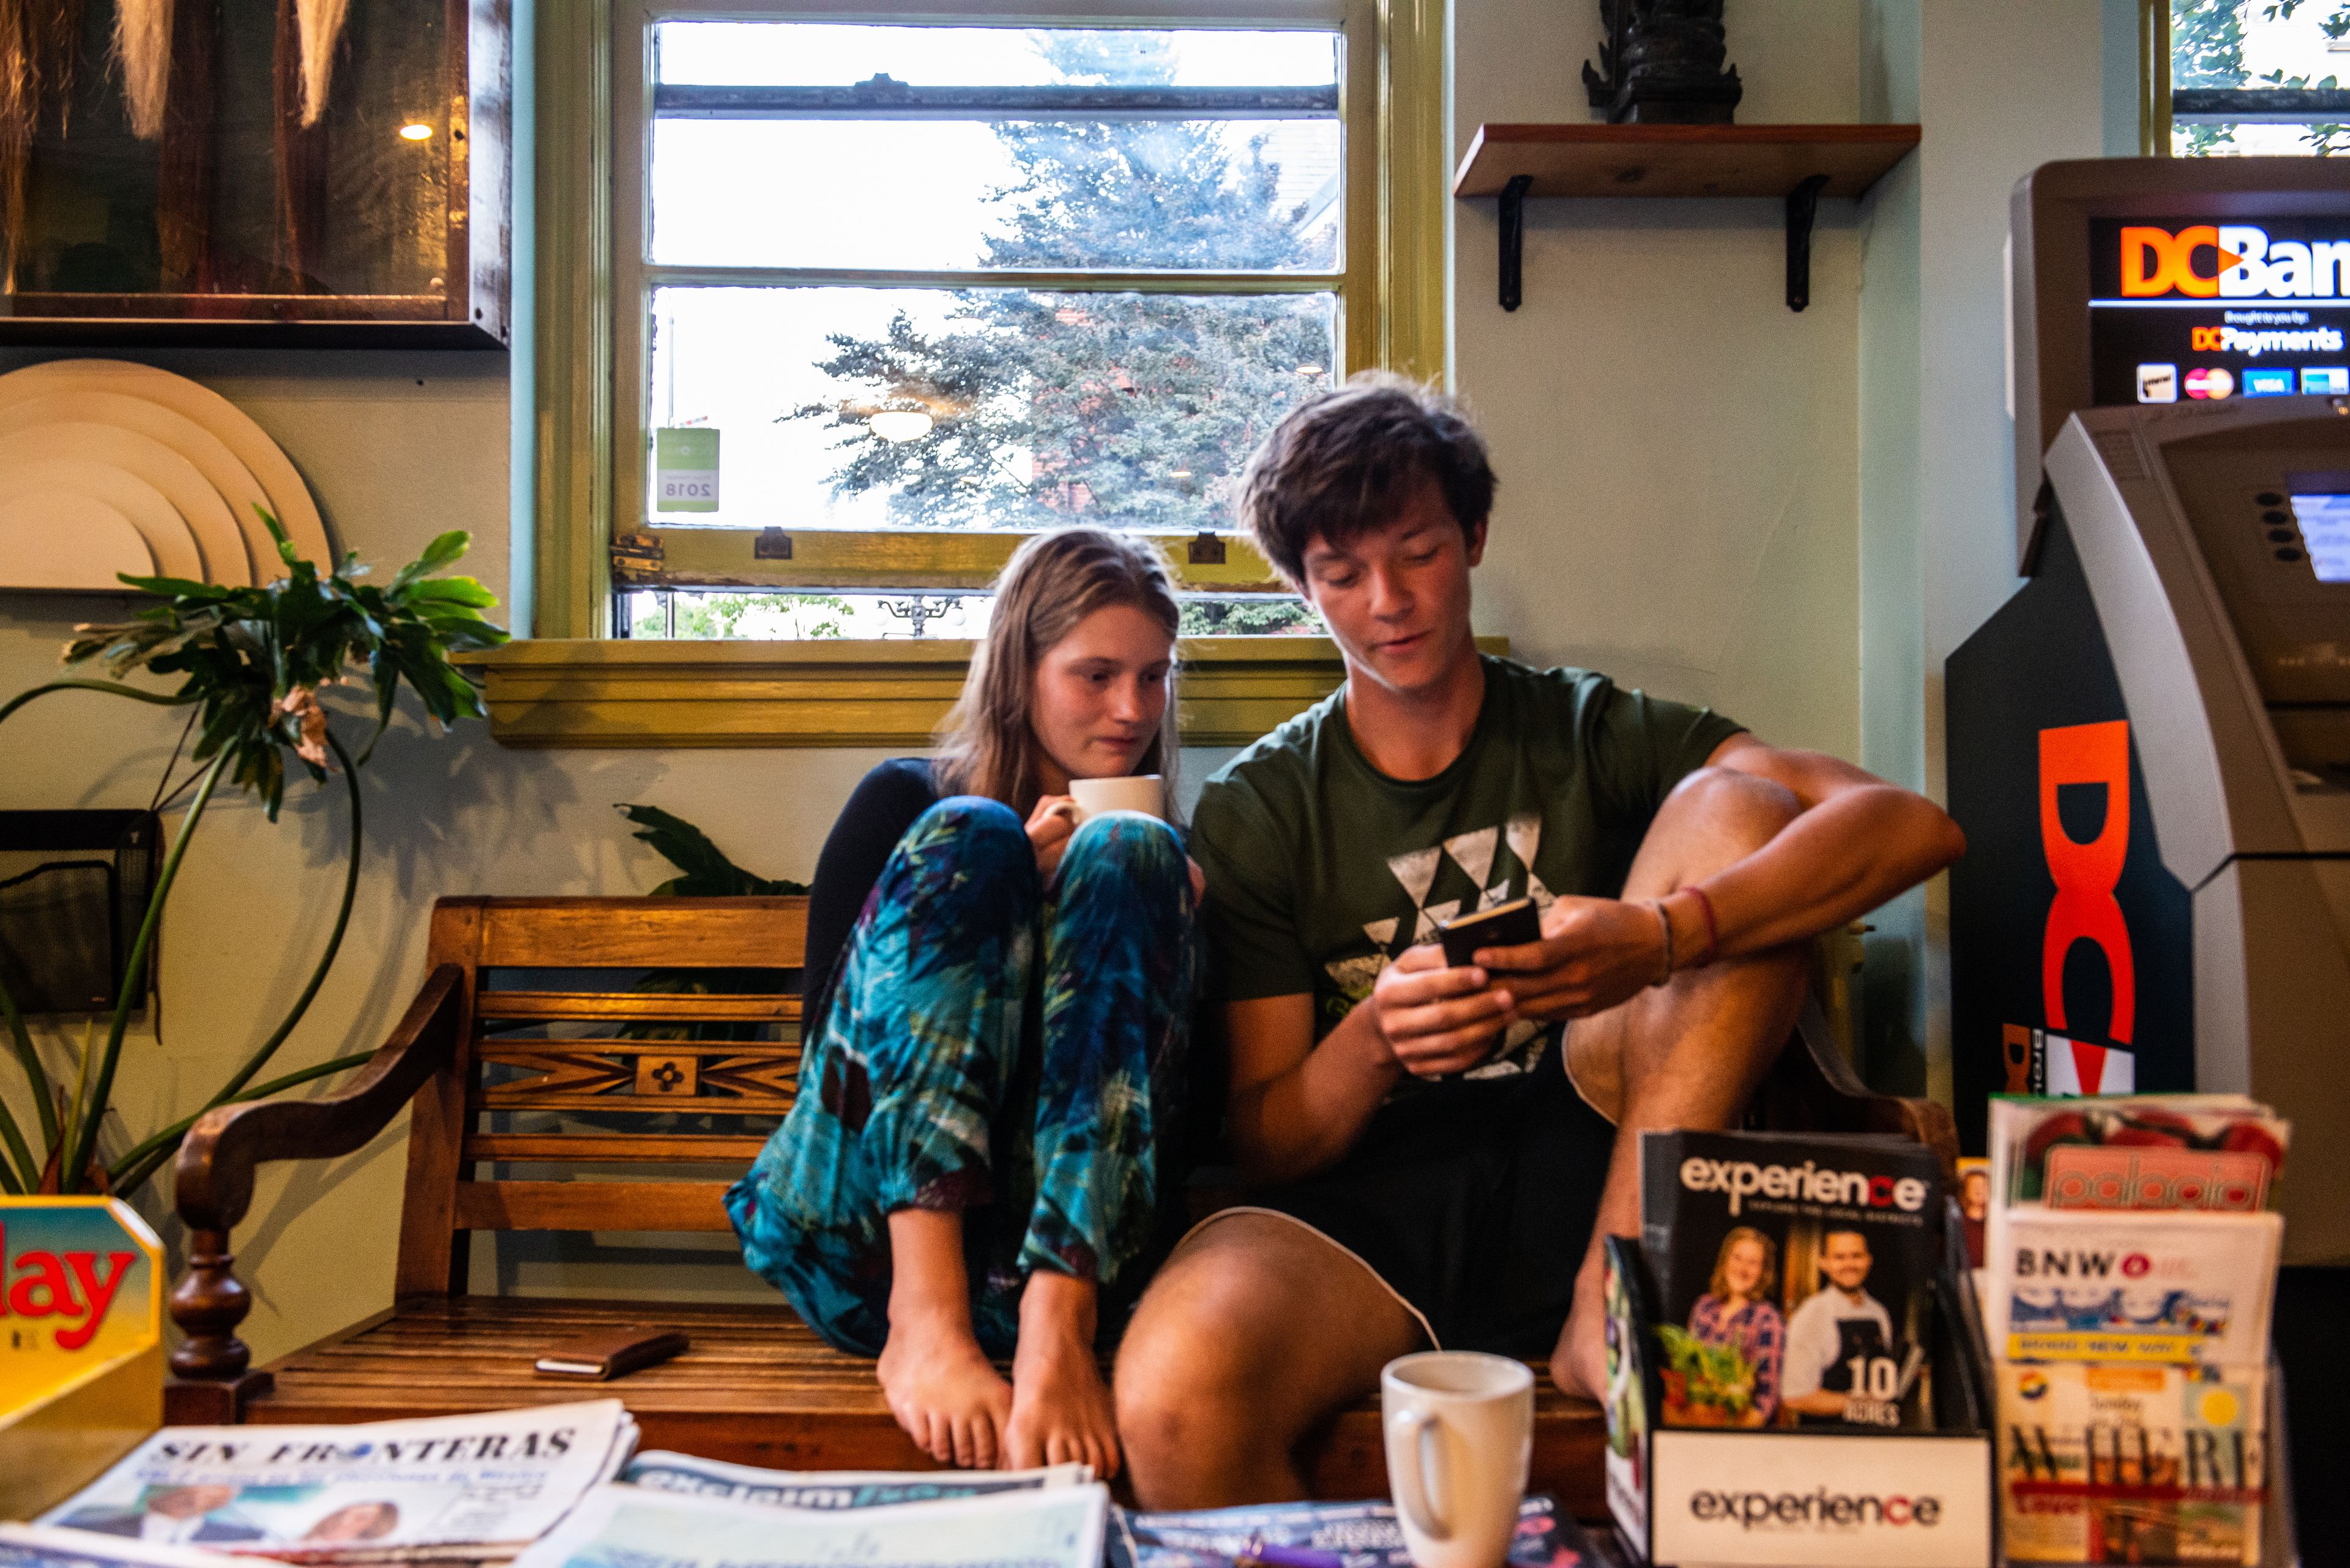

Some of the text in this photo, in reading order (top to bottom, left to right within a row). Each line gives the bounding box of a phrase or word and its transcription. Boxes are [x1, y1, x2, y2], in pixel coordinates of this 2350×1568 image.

[2120, 225, 2350, 297] DCBan
[1680, 1155, 1926, 1217] experience
[0, 1220, 136, 1351] ay
[2016, 1248, 2115, 1277] BNW
[1846, 1354, 1898, 1400] 10
[151, 1441, 247, 1463] SIN
[1689, 1484, 1942, 1533] experience
